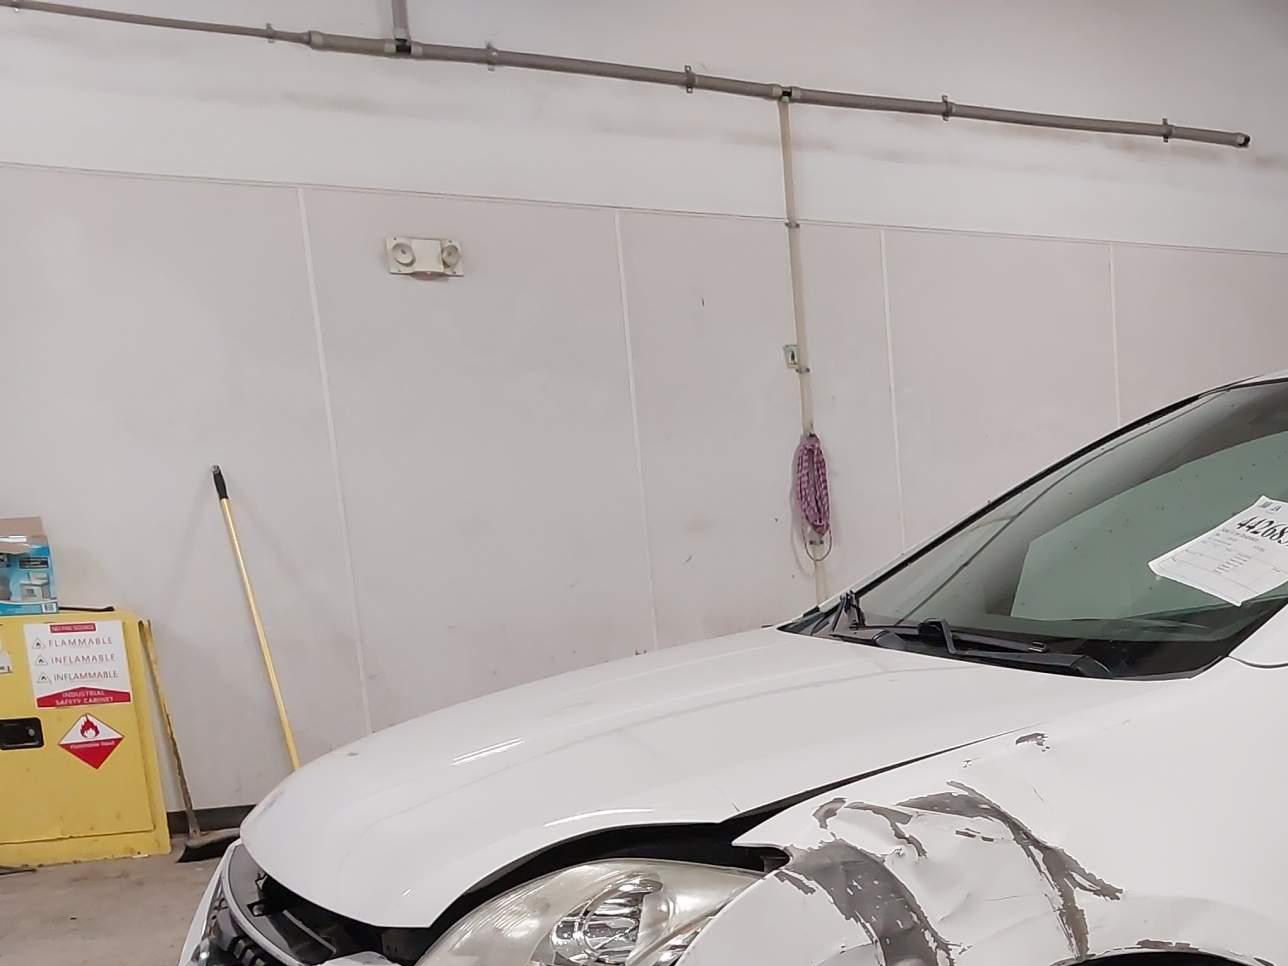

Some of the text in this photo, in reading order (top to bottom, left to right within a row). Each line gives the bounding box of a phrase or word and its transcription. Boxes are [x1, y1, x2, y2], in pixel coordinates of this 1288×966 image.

[48, 637, 112, 648] FLAMMABLE
[51, 653, 115, 664] INFLAMABLE
[53, 670, 119, 681] INFLAMMABLE
[55, 697, 81, 705] SAFETY
